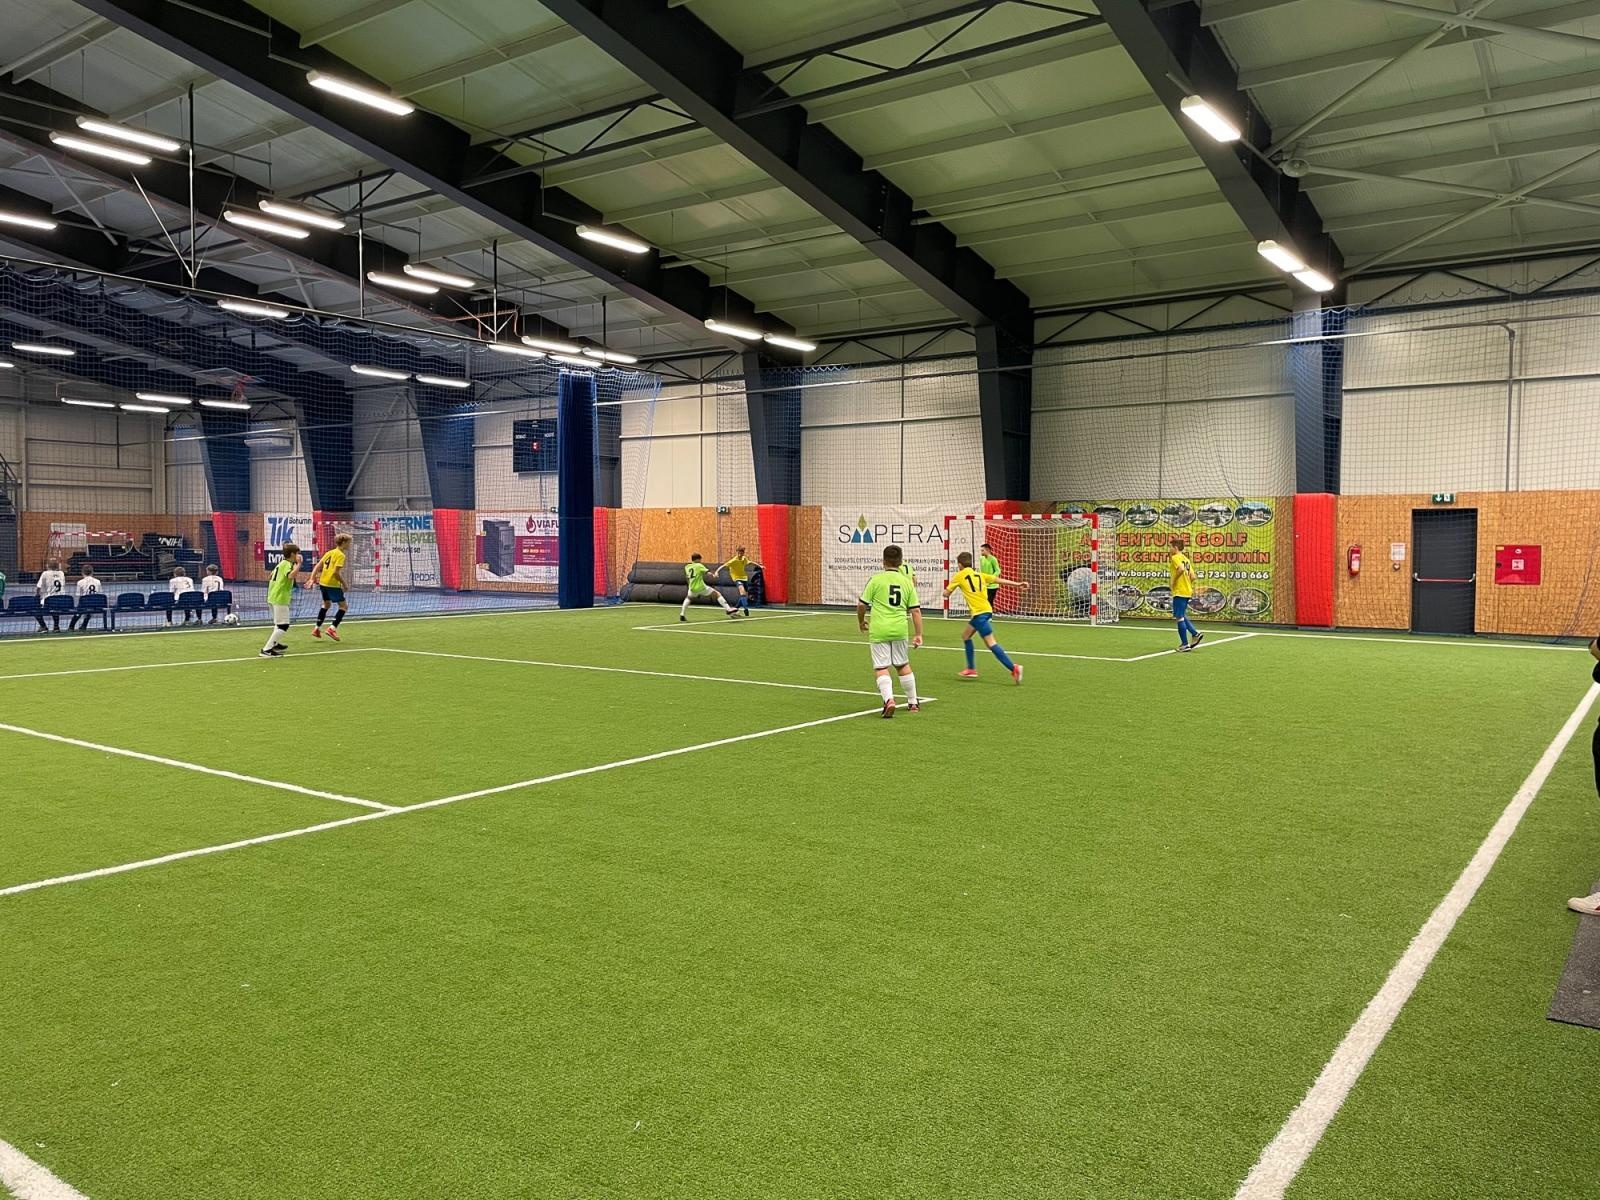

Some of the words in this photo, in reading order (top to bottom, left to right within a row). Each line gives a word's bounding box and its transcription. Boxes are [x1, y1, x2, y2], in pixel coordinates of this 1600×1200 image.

[1195, 532, 1247, 547] GOLF
[325, 556, 332, 569] 4
[1193, 549, 1270, 563] BOHUMÍN
[688, 568, 695, 579] 2
[1208, 571, 1226, 579] 734
[1229, 571, 1247, 579] 788
[1250, 571, 1269, 579] 666
[54, 580, 61, 592] 9
[965, 574, 982, 592] 17
[889, 584, 901, 607] 5
